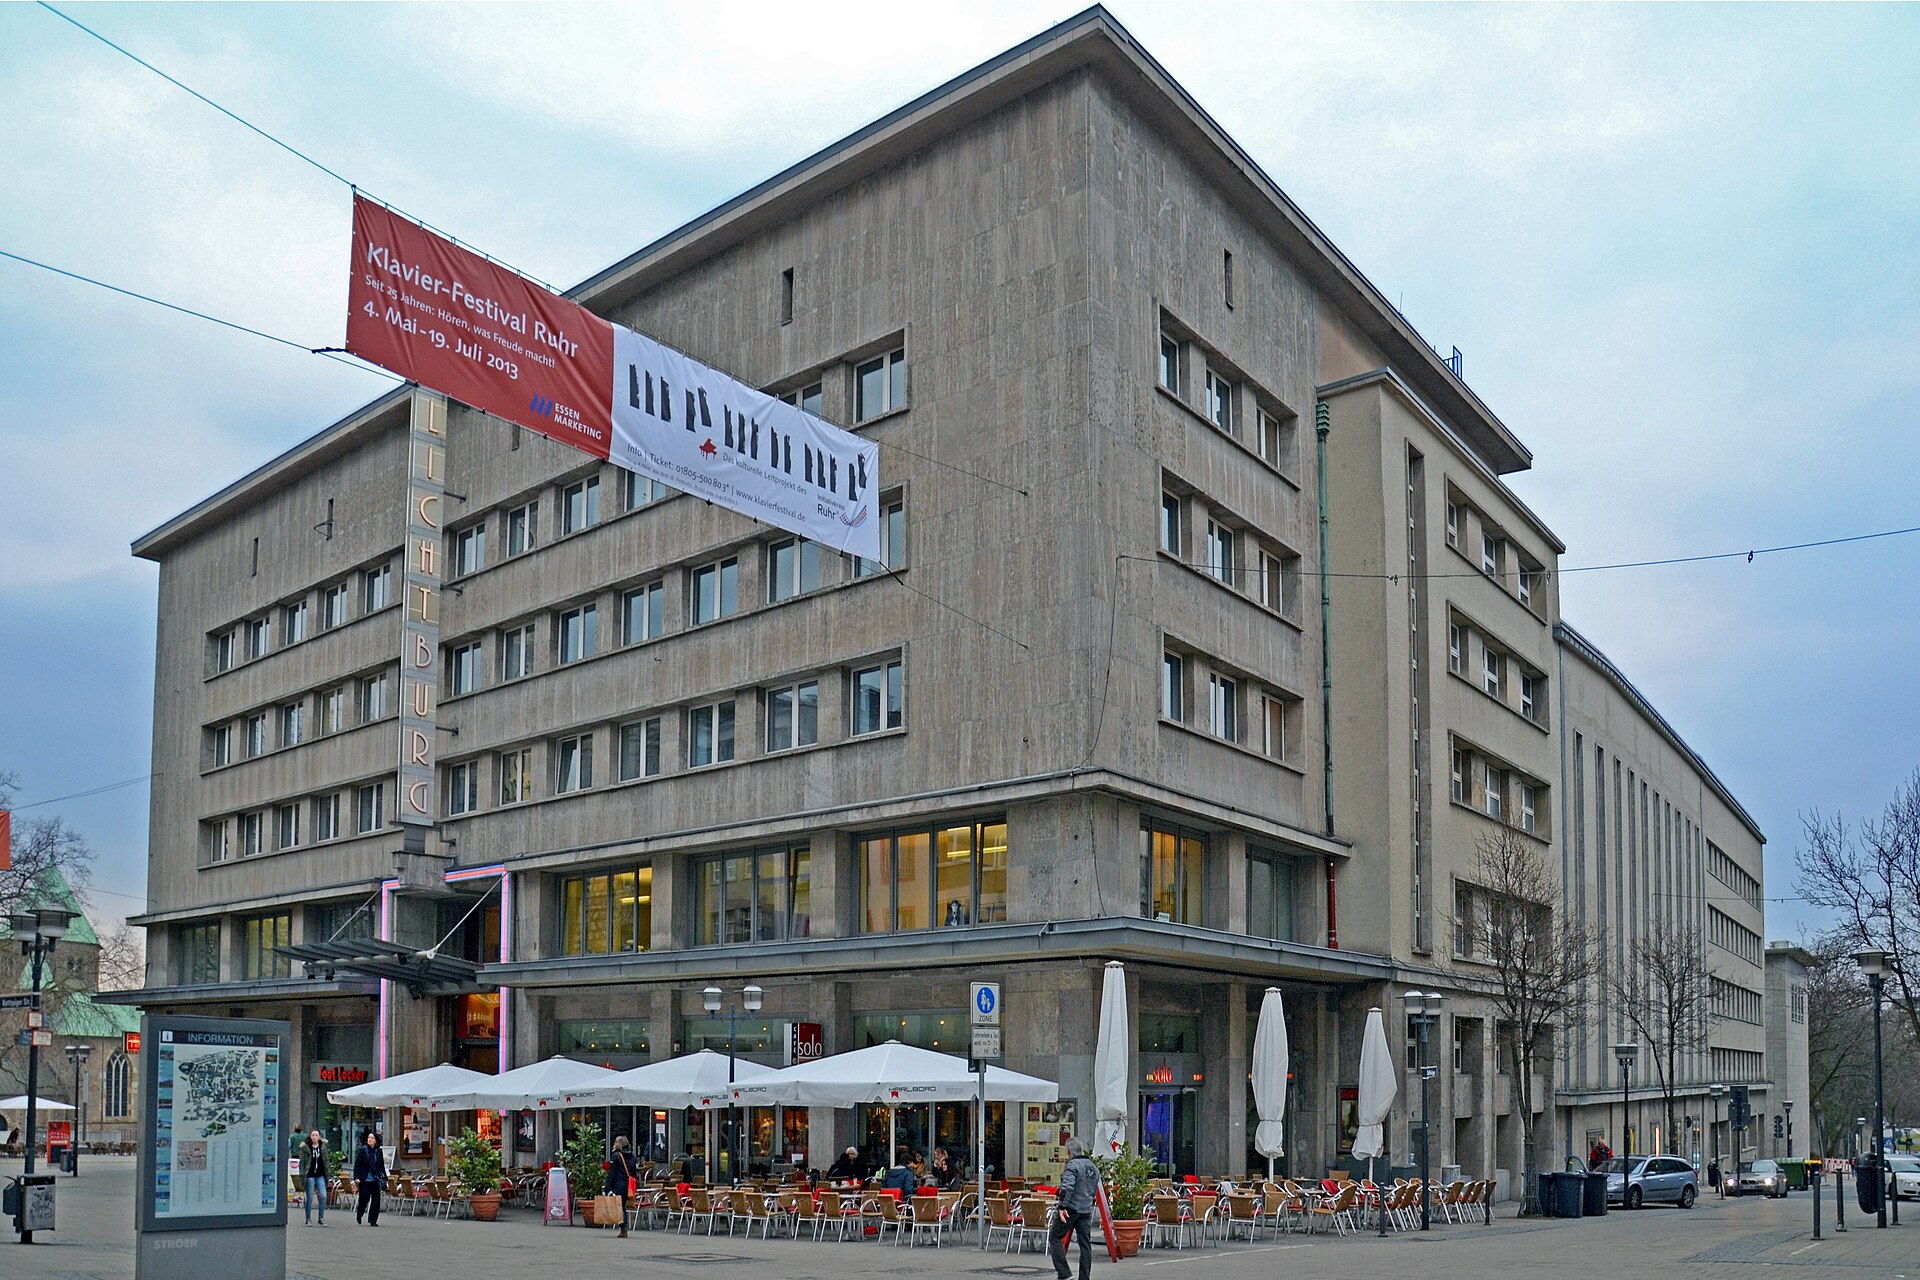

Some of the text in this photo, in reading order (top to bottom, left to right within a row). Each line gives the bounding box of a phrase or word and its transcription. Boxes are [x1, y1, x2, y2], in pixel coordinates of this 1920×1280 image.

[367, 242, 578, 358] Klavier-Festival Ruhr
[365, 274, 555, 369] Seit 25 Jahren: Hören, was Freude macht!
[363, 300, 380, 319] 4.
[454, 339, 482, 362] Juli
[486, 353, 519, 380] 2013
[554, 402, 580, 420] ESSEN
[554, 413, 602, 440] MARKETING
[627, 443, 643, 458] Info
[649, 453, 674, 473] Ticket:
[735, 489, 806, 523] www.klavierfestival.de
[723, 452, 807, 495] Das kulturelle Leitprojekt des
[817, 503, 836, 520] Ruhr
[408, 397, 439, 814] LICHTBURG
[188, 1033, 253, 1045] INFORMATION
[799, 1033, 822, 1056] solo
[319, 1065, 367, 1082] Foot Locker
[1153, 1058, 1173, 1083] solo
[153, 1238, 198, 1249] STRÖER
